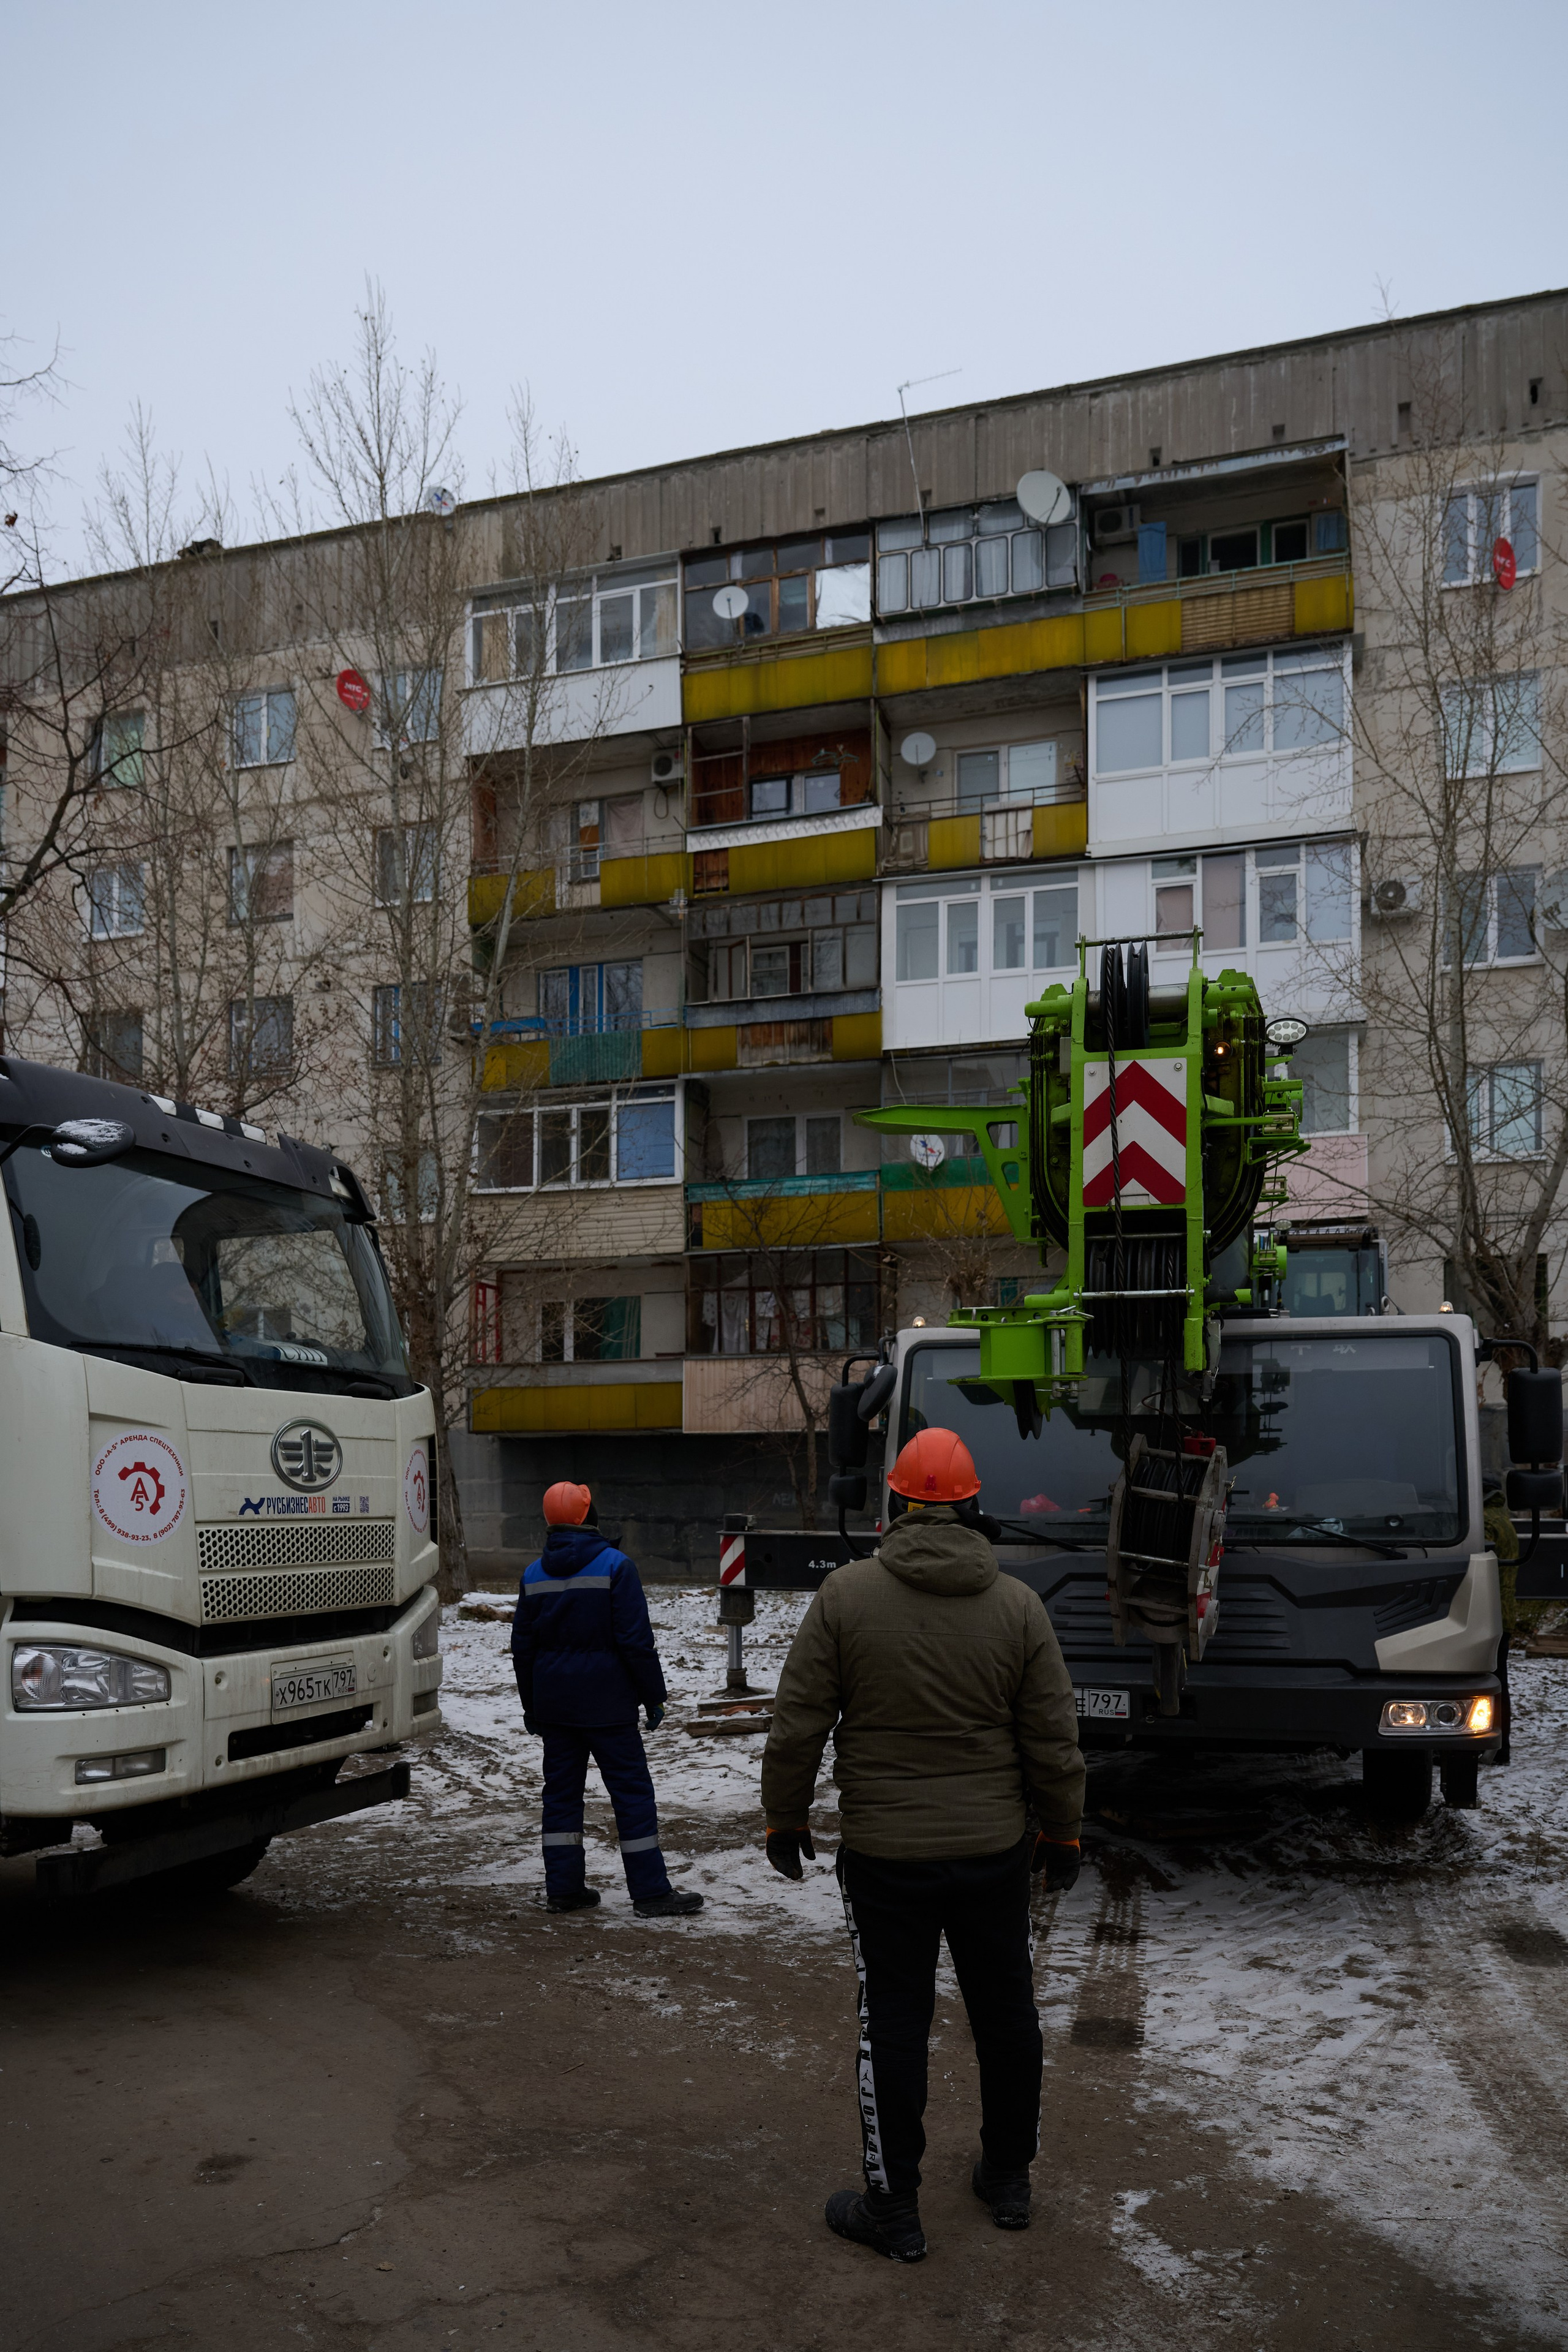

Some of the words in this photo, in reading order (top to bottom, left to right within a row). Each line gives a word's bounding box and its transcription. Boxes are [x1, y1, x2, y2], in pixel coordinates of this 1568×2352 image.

[96, 1459, 105, 1475] ООО
[120, 1434, 148, 1446] АРЕНДА
[149, 1436, 184, 1476] СПЕЦТЕХНИКИ
[130, 1477, 149, 1501] А
[135, 1495, 144, 1512] 5
[266, 1496, 326, 1514] РУСБИЗНЕСАВТО
[101, 1514, 117, 1531] (499)
[159, 1522, 174, 1537] (902)
[809, 1560, 837, 1569] 4.3m
[333, 1669, 352, 1688] 797
[1091, 1693, 1121, 1709] 797
